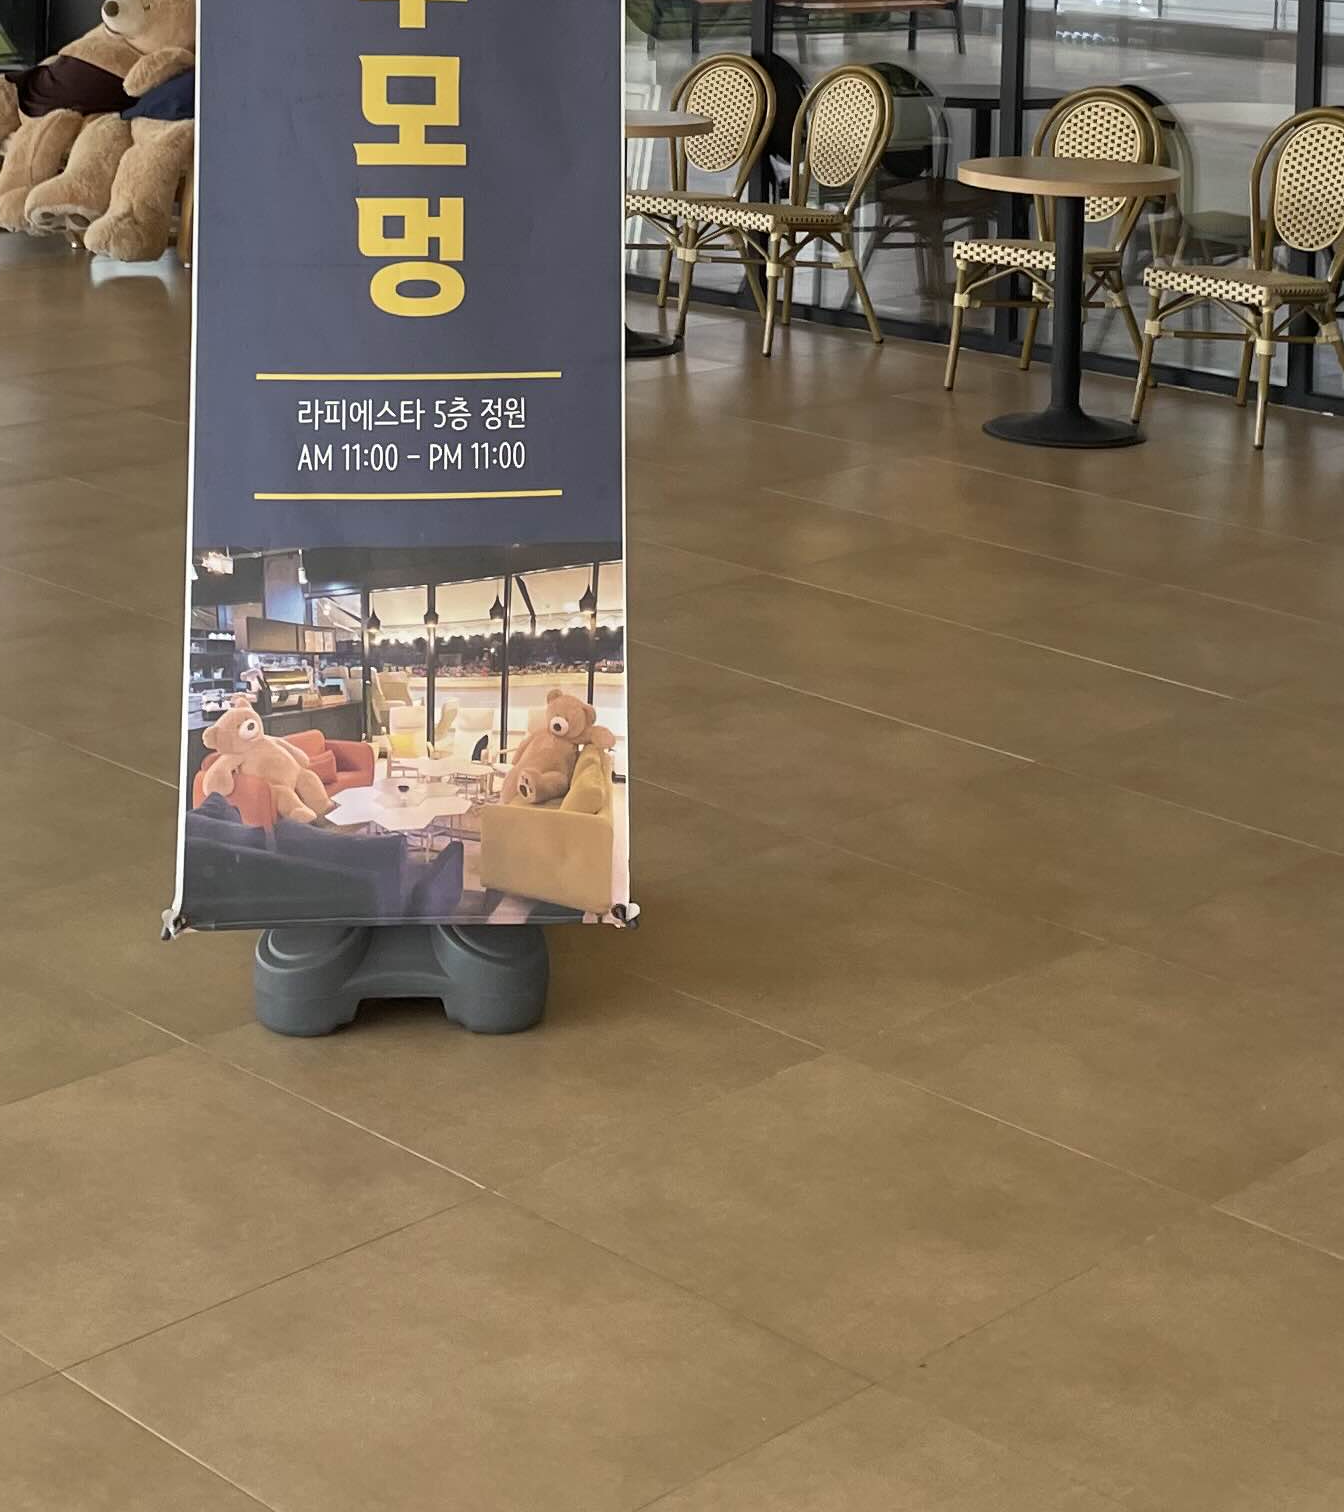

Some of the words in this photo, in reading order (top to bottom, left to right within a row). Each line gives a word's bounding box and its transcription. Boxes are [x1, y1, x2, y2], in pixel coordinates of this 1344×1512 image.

[297, 398, 426, 431] 라피에스타
[433, 396, 472, 431] 5층
[480, 396, 526, 430] 정원
[297, 443, 333, 471] AM
[341, 443, 398, 472] 11:00
[429, 443, 462, 471] PM
[470, 441, 526, 470] 11:00
